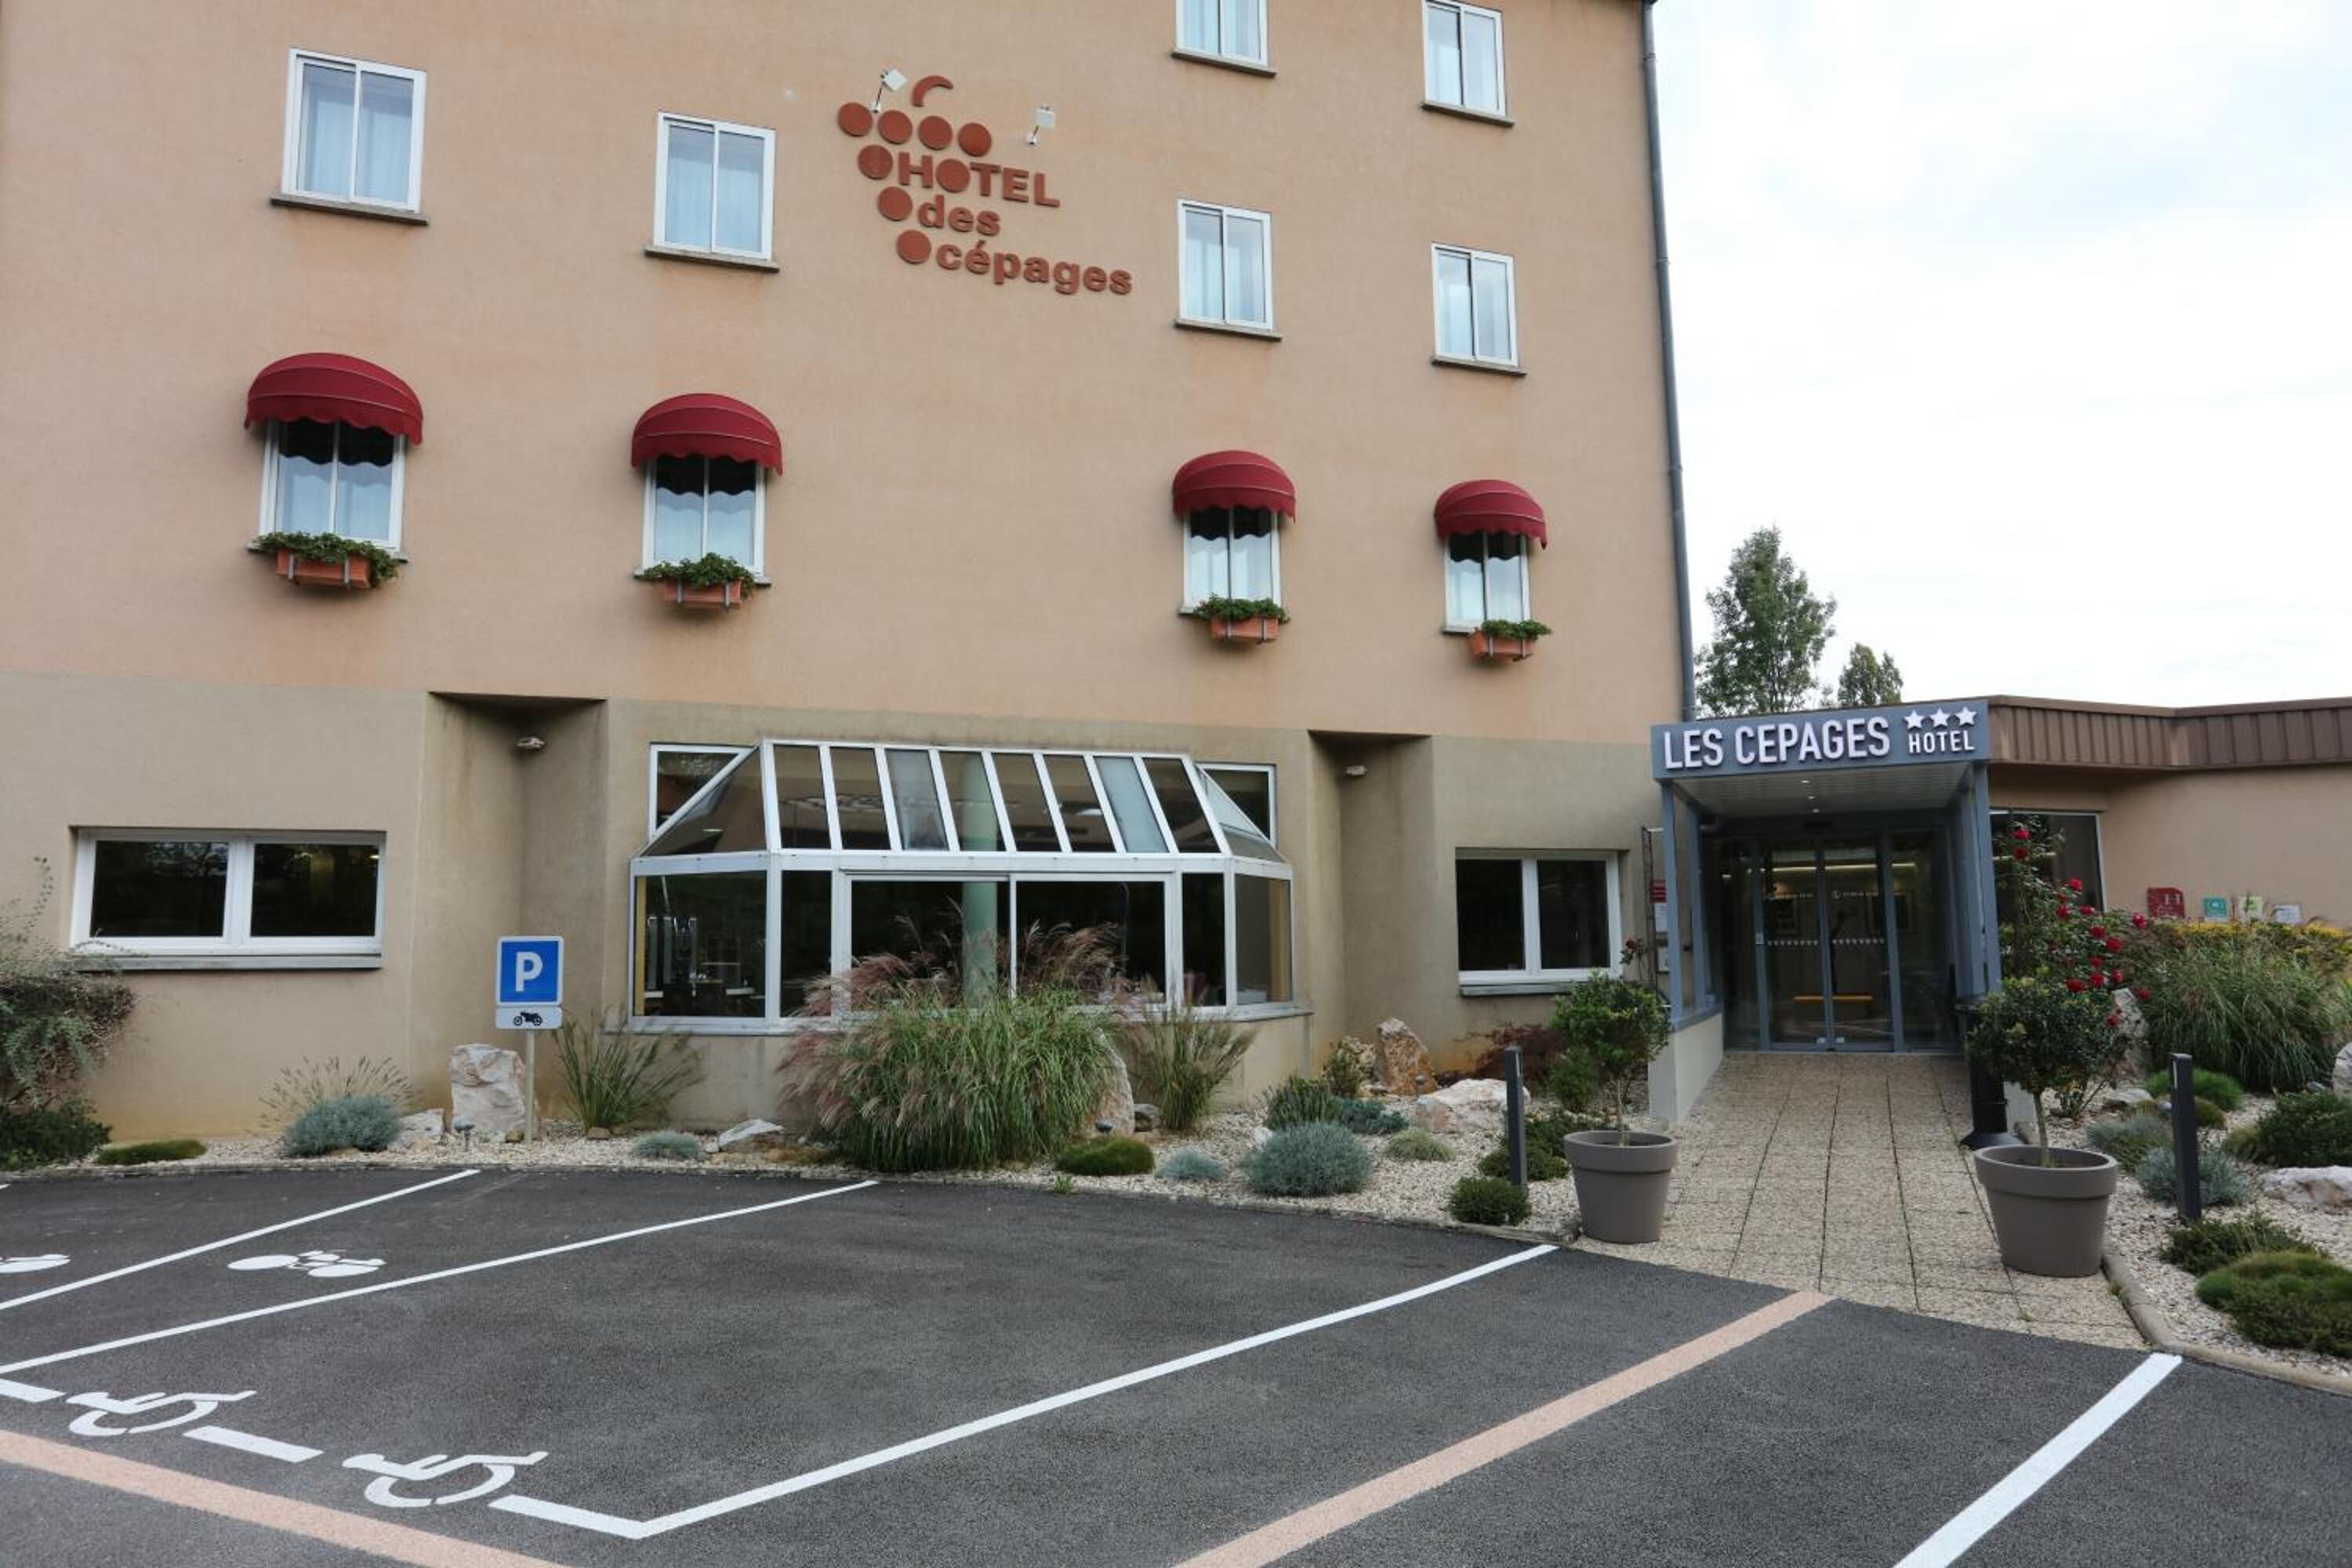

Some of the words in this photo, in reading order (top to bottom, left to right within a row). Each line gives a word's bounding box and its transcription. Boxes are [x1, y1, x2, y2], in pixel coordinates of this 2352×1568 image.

[898, 151, 1061, 208] HOTEL
[918, 194, 1000, 236] des
[936, 240, 1132, 295] cépages
[1664, 728, 1724, 769] LES
[1735, 717, 1890, 765] CEPAGES
[1908, 731, 1975, 753] HOTEL
[515, 951, 543, 992] P
